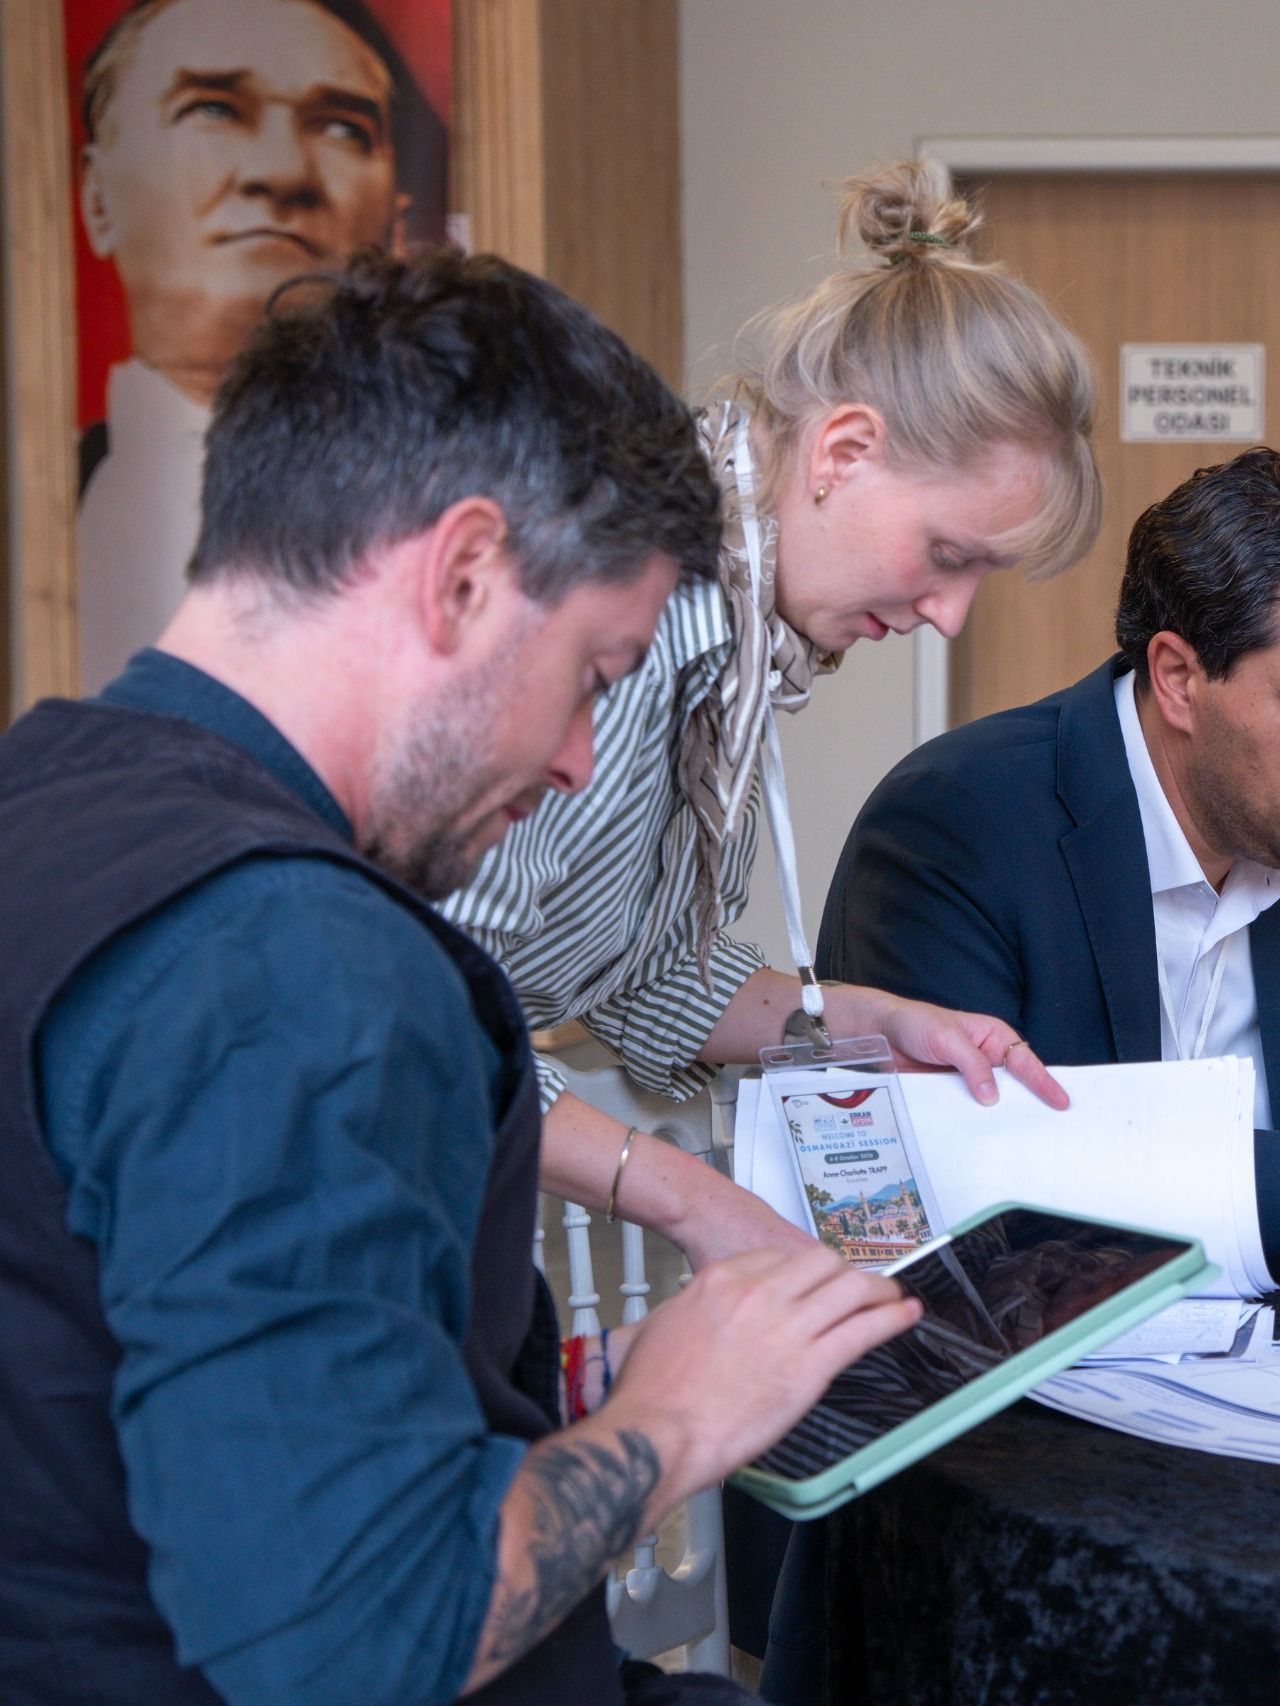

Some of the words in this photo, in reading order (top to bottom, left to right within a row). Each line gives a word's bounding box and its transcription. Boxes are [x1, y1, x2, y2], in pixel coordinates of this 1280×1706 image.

[1128, 384, 1255, 407] PERSONEL
[1153, 411, 1231, 434] ODASI
[821, 1131, 855, 1141] WELCOME
[859, 1137, 897, 1147] SESSION
[868, 1165, 888, 1174] TRAPP
